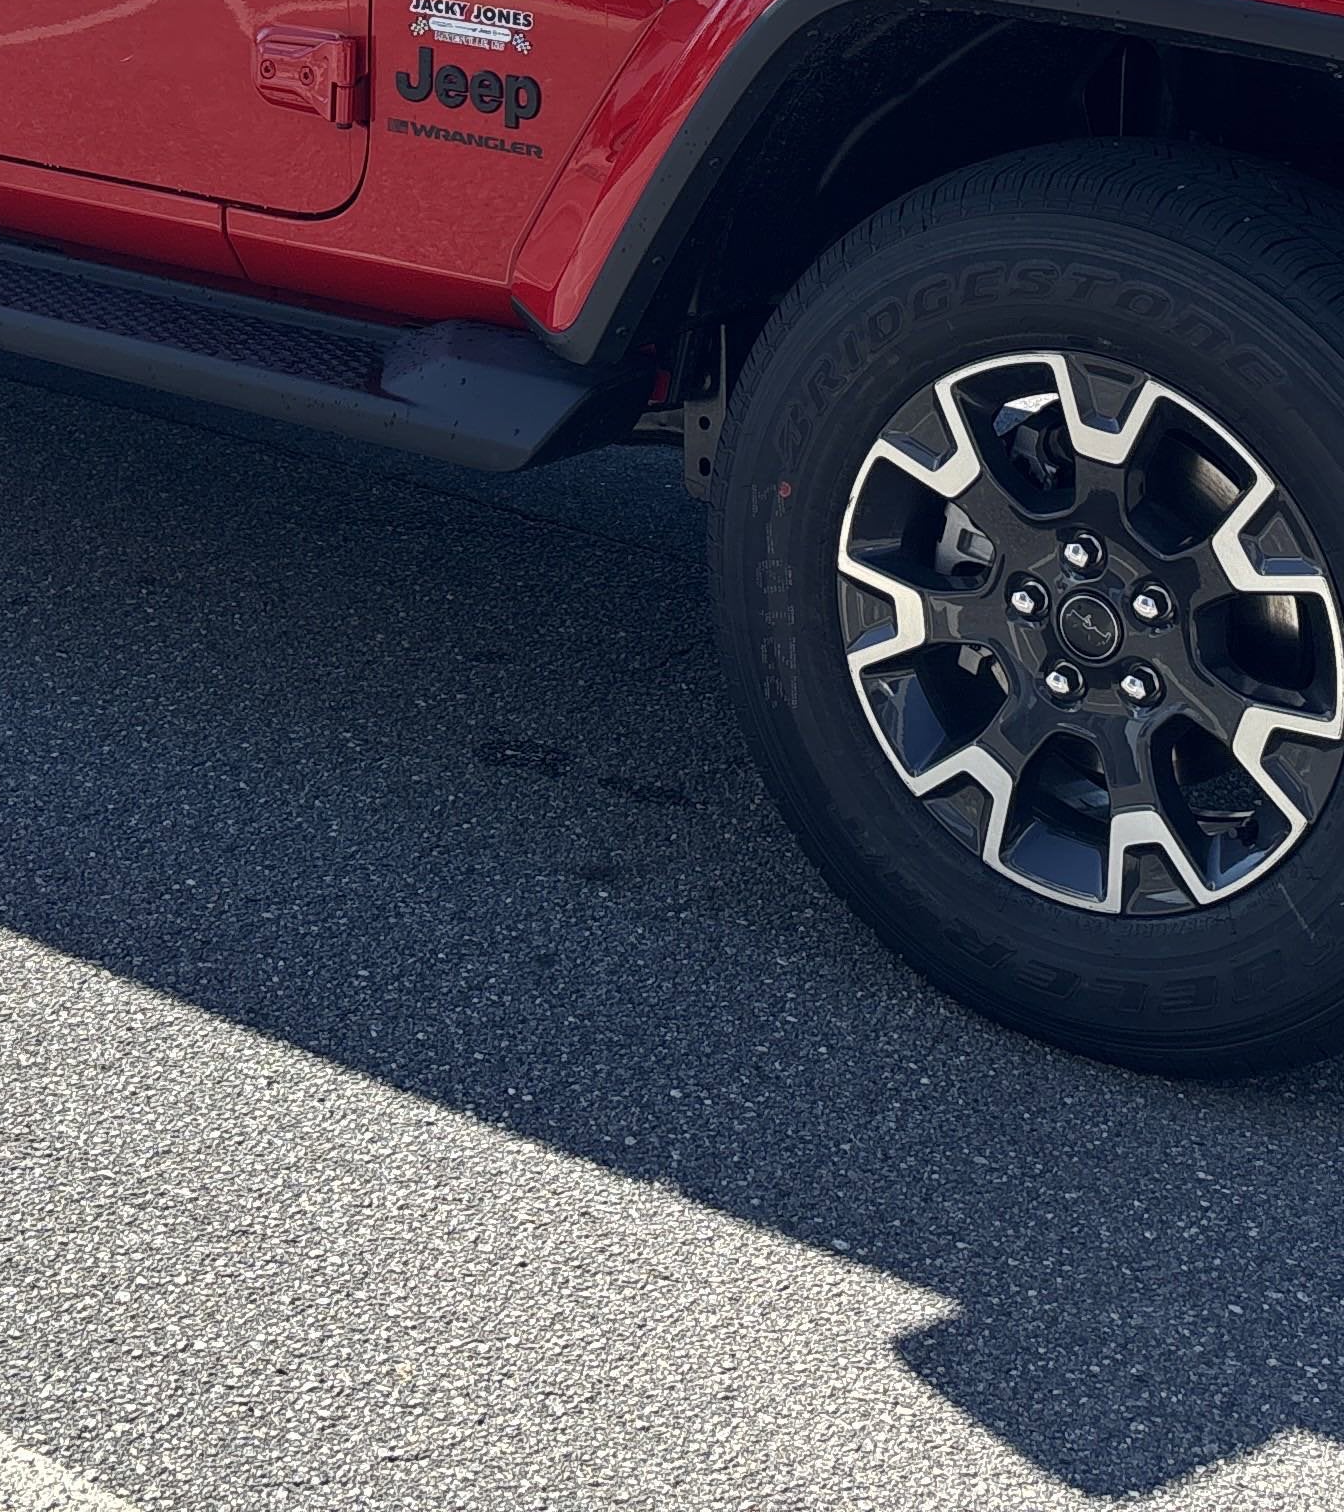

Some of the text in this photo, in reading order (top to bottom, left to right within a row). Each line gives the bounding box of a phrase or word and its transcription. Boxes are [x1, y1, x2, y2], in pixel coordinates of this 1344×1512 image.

[474, 5, 533, 28] JONES
[395, 46, 543, 130] Jeep
[410, 121, 544, 159] WRANGLER
[772, 258, 1288, 470] BRIDGESTONE
